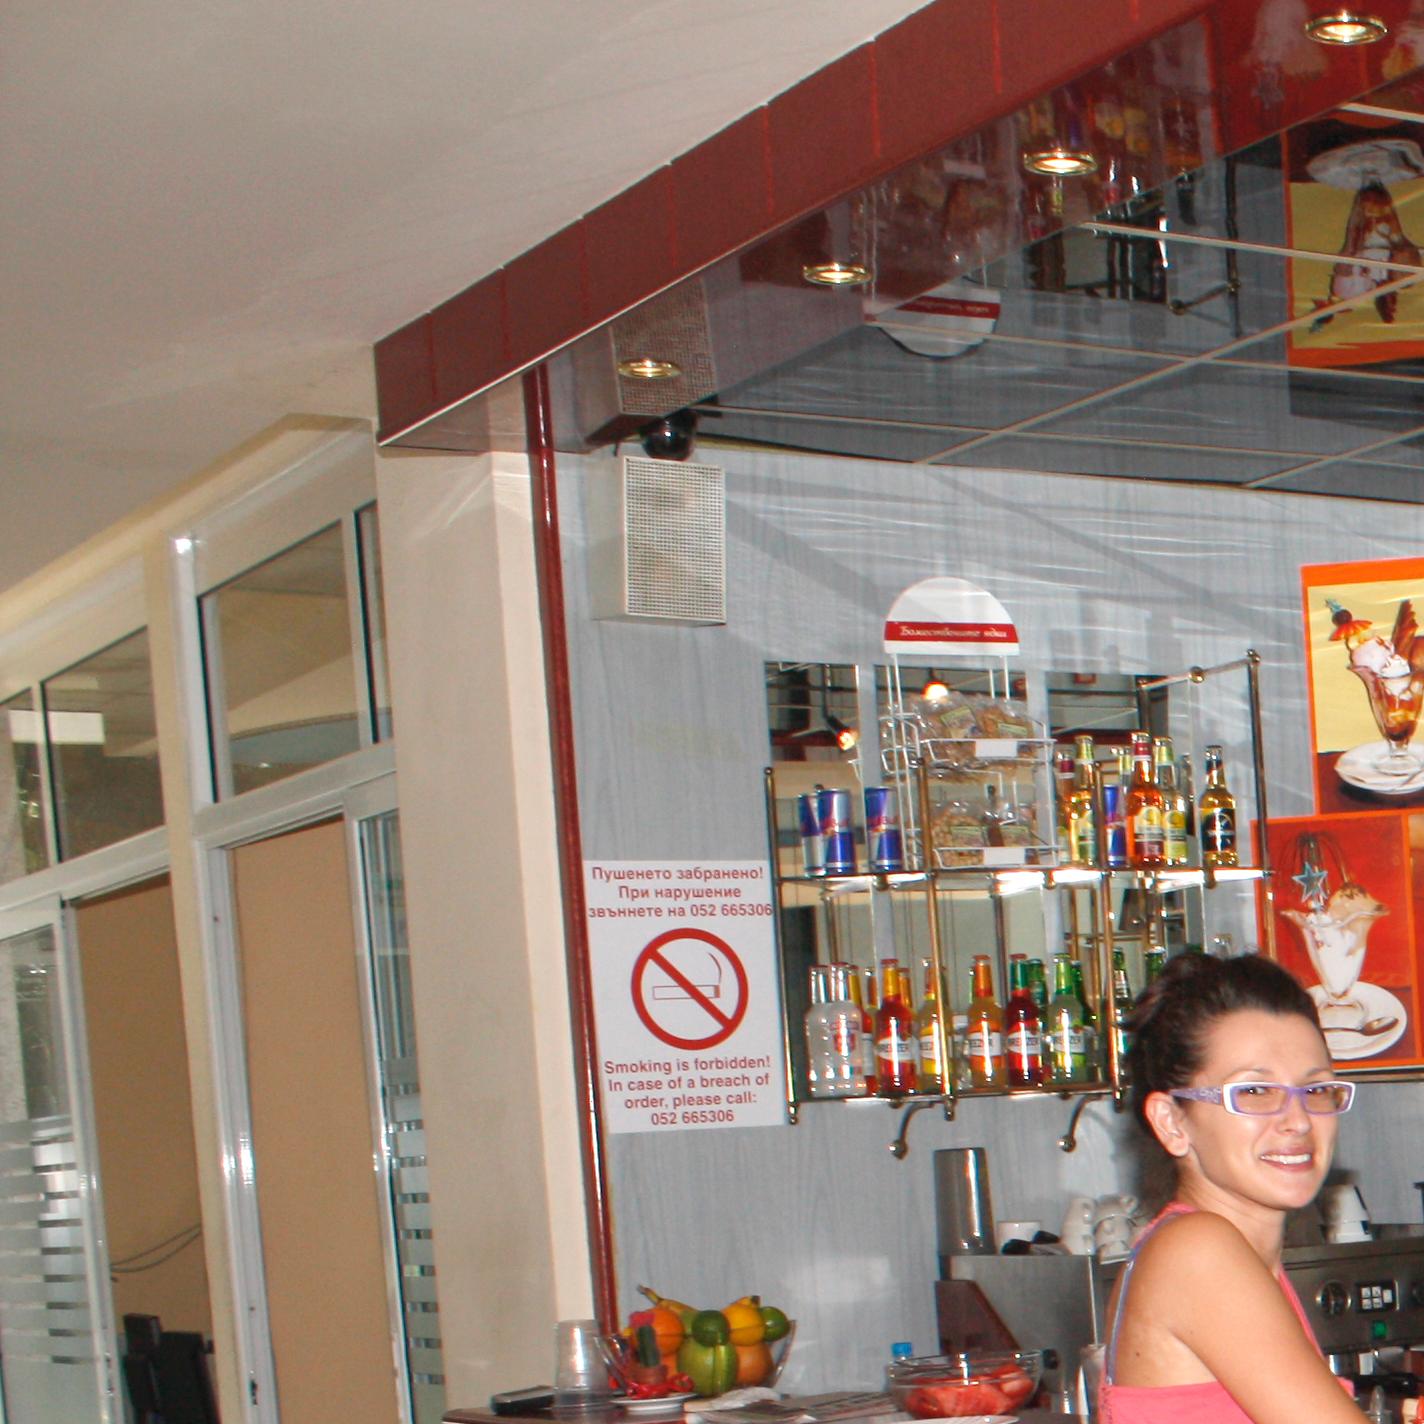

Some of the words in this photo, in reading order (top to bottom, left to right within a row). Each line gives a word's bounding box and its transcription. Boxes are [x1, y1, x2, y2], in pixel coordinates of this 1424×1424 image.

[592, 867, 672, 881] Пушенето
[676, 866, 763, 884] забранено!
[618, 886, 650, 901] При
[655, 886, 742, 901] нарушение
[589, 906, 663, 918] звъннете
[668, 906, 686, 917] на
[690, 904, 718, 916] 052
[721, 904, 773, 916] 665306
[604, 1061, 672, 1076] Smoking
[676, 1058, 689, 1071] is
[694, 1056, 770, 1070] forbidden!
[609, 1078, 623, 1091] In
[627, 1079, 662, 1090] case
[668, 1076, 682, 1089] of
[687, 1079, 695, 1088] a
[700, 1075, 750, 1087] breach
[755, 1073, 770, 1086] of
[625, 1096, 667, 1110] order,
[672, 1094, 721, 1110] please
[726, 1093, 757, 1104] call:
[651, 1113, 677, 1125] 052
[682, 1110, 734, 1124] 665306
